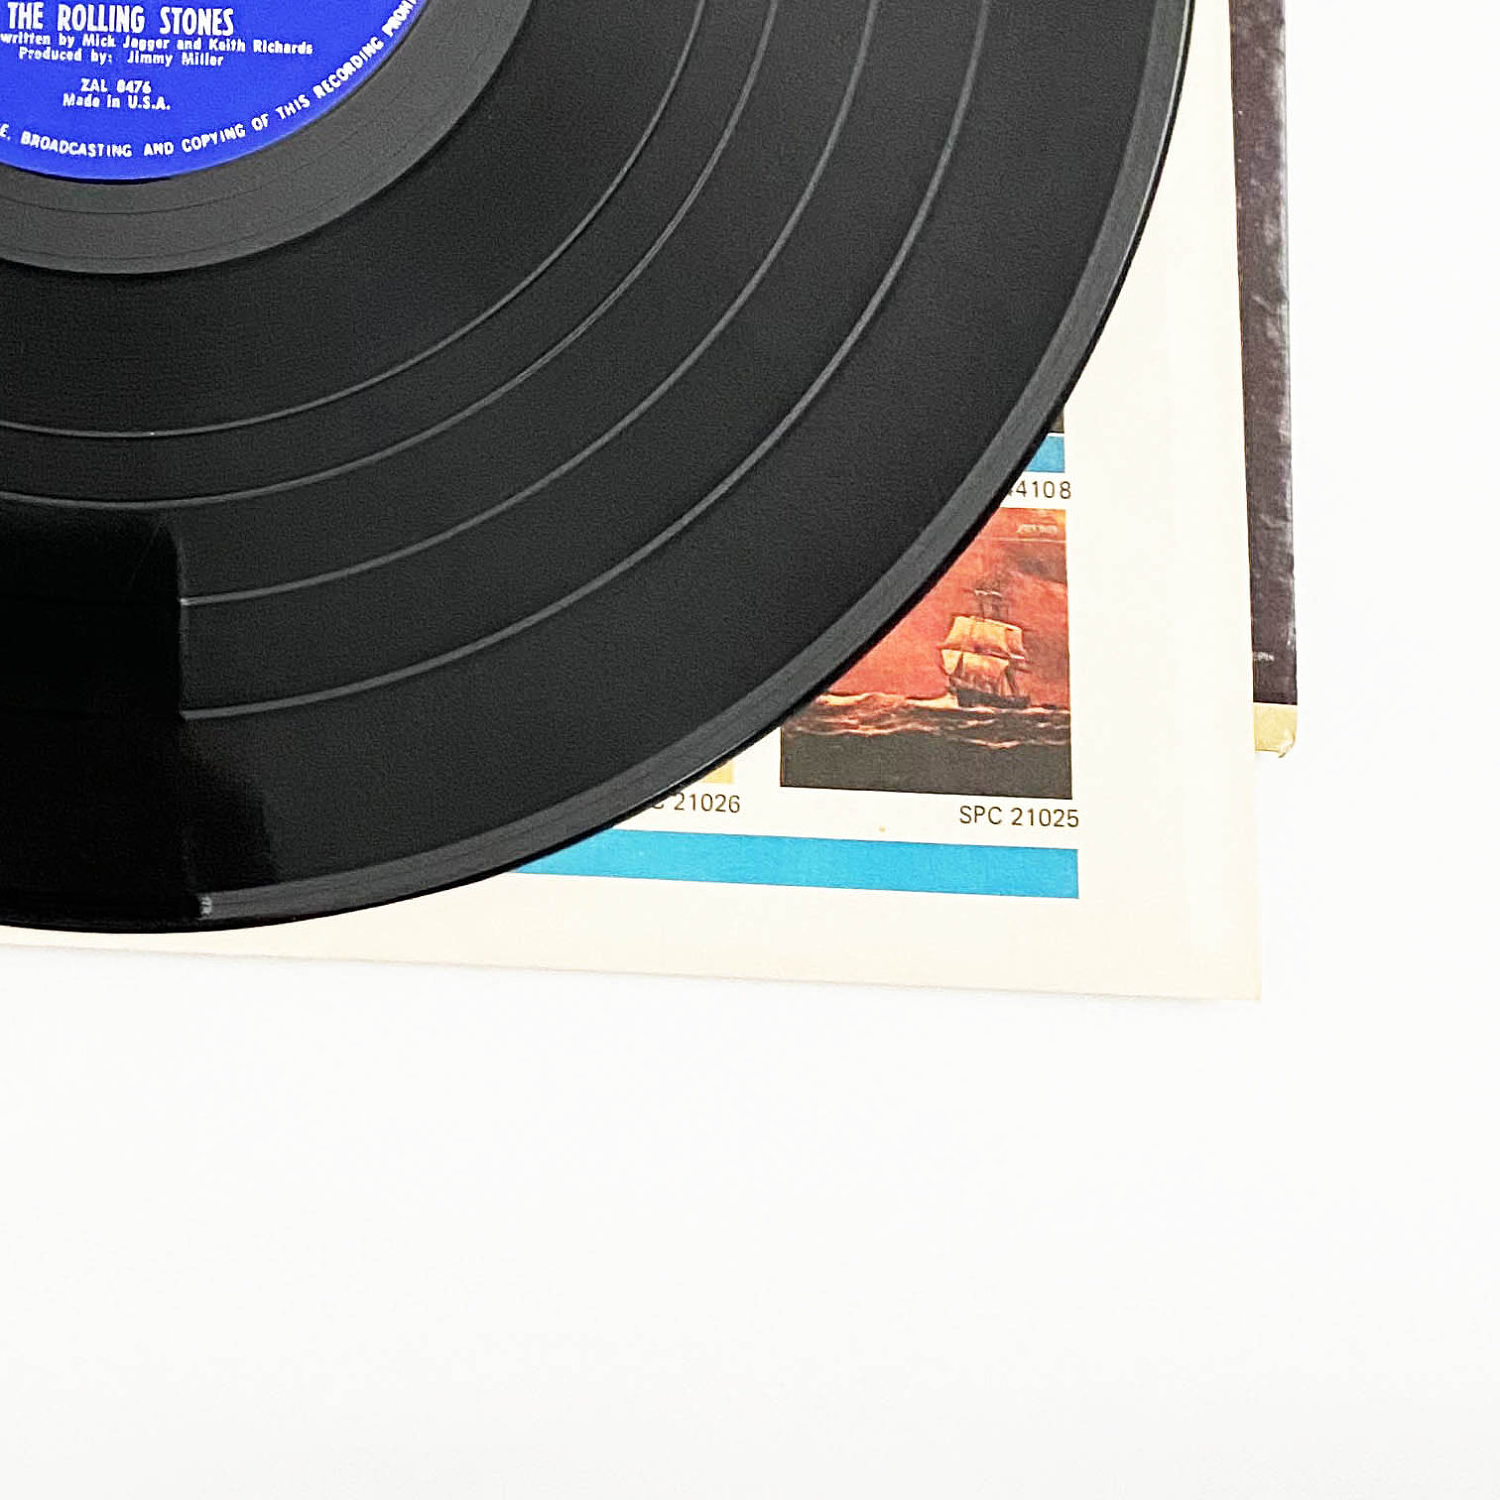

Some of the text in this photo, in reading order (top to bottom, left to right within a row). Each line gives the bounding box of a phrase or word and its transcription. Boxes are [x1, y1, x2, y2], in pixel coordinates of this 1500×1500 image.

[7, 1, 234, 37] THE ROLLING STONES
[0, 31, 51, 45] written
[58, 32, 75, 49] by
[82, 33, 117, 48] Mick
[122, 34, 170, 52] Jagger
[176, 37, 202, 51] and
[208, 38, 246, 53] Keith
[253, 39, 313, 55] Richards
[18, 46, 224, 67] Produced by: Jimmy Miller
[19, 130, 133, 158] BROADCASTING
[143, 141, 175, 157] AND
[181, 122, 247, 153] COPYING
[250, 112, 269, 132] OF
[275, 94, 311, 120] THIS
[312, 36, 385, 99] RECORDING
[80, 78, 152, 94] ZAL 8476
[62, 93, 171, 111] Made in U.S.A.
[673, 791, 741, 813] 21026
[959, 804, 1079, 828] SPC 21025
